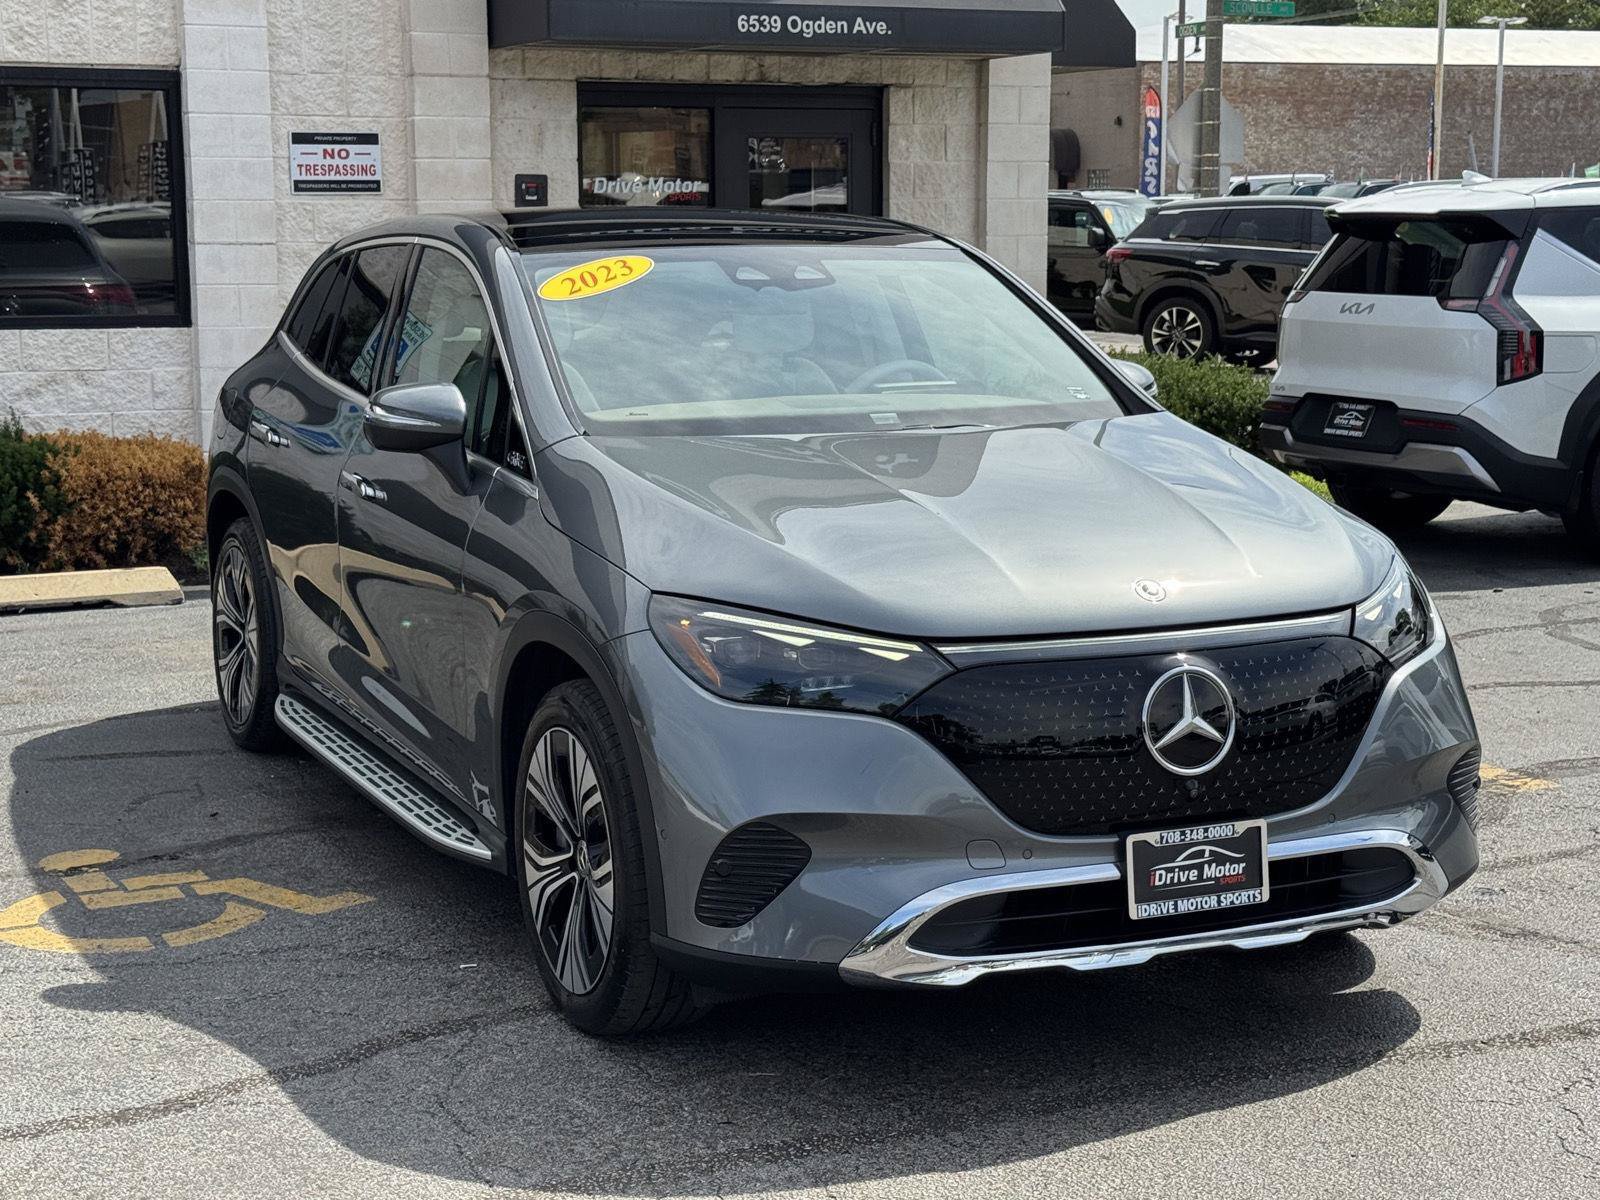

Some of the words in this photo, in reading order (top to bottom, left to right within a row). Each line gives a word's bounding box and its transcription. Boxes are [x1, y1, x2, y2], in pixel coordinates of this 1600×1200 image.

[1229, 2, 1273, 13] SCOVILLE
[737, 15, 781, 33] 6539
[787, 15, 848, 38] Ogden
[852, 17, 892, 35] Ave.
[322, 148, 350, 160] NO
[297, 164, 376, 176] TRESPASSING
[648, 177, 702, 192] Motor
[667, 192, 702, 202] SPORTS
[560, 259, 634, 296] 2023
[1339, 302, 1375, 315] KIA
[1161, 825, 1233, 844] 708-348-0000
[1149, 867, 1198, 887] iDrive
[1203, 861, 1247, 880] Motor
[1220, 874, 1247, 886] SPORTS
[1177, 895, 1218, 913] MOTOR
[1220, 889, 1261, 907] SPORTS
